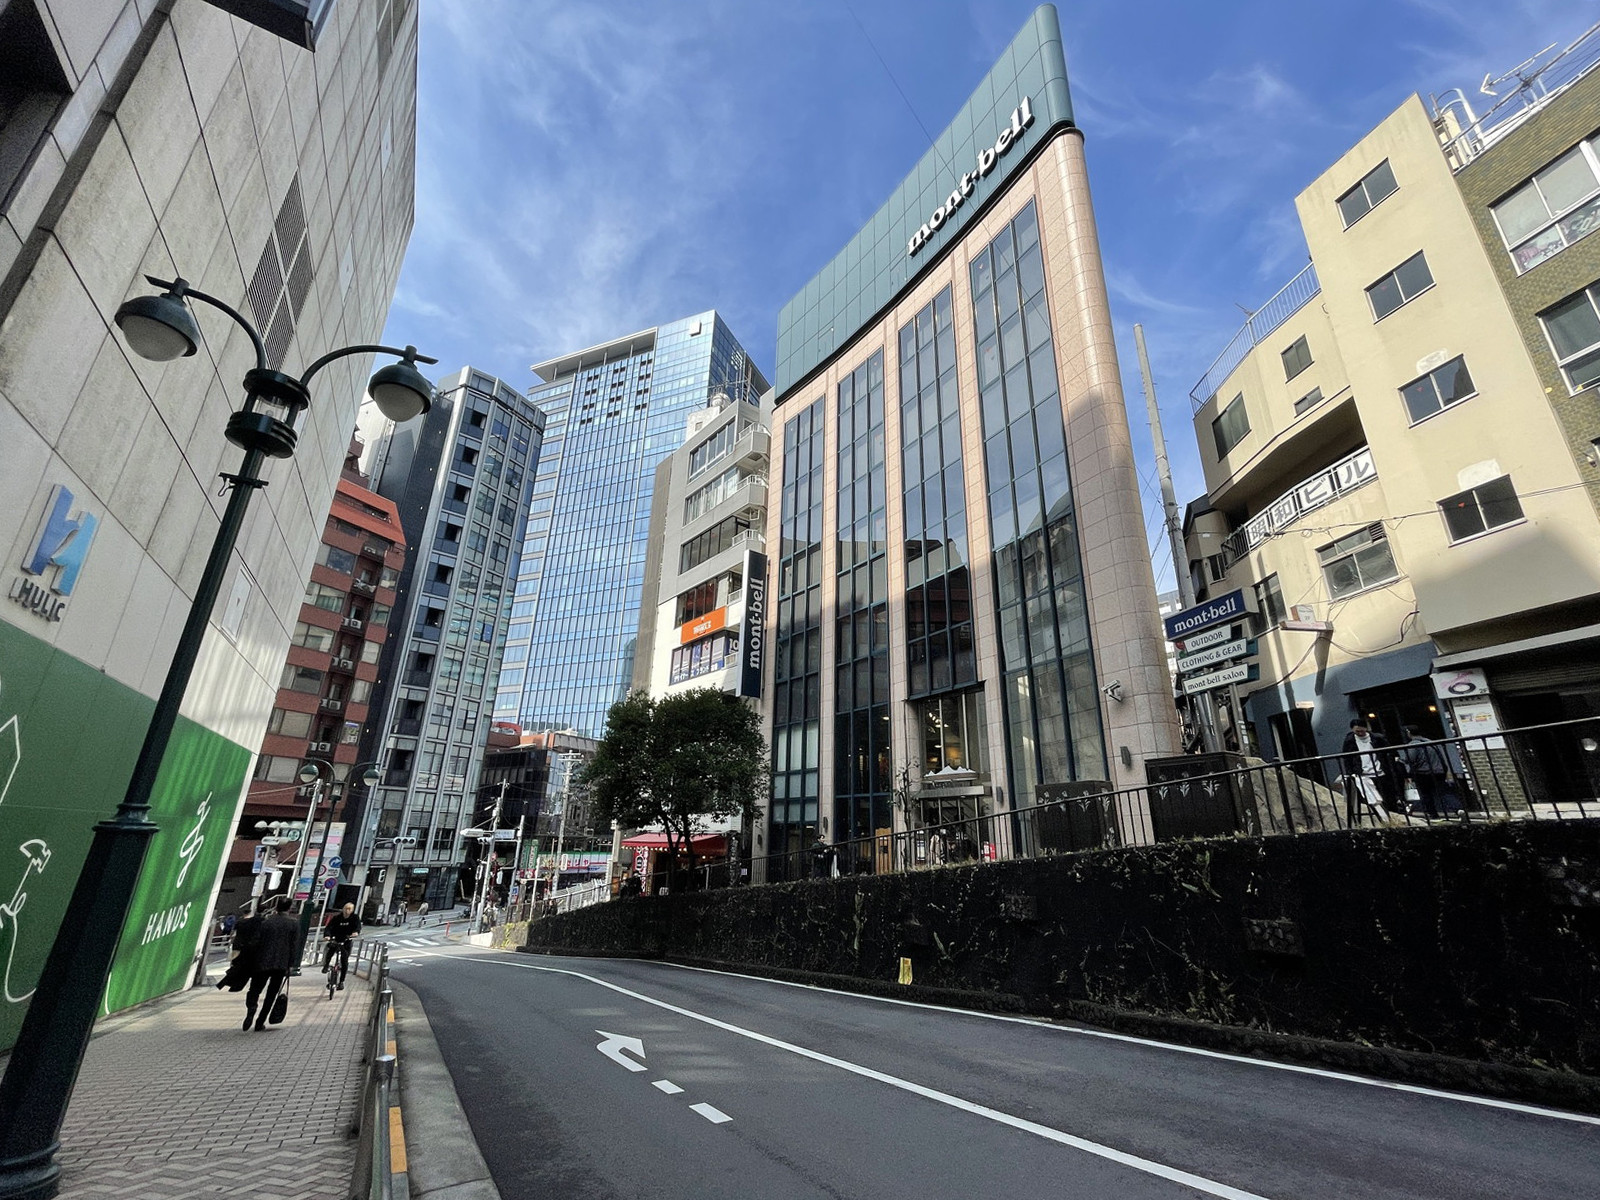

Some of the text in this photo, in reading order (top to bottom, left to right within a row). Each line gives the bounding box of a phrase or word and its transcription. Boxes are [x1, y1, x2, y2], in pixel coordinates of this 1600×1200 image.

[1250, 460, 1370, 540] 昭和ビル
[1191, 631, 1223, 648] OUTDOOR
[1181, 652, 1215, 669] CLOTHING
[1222, 643, 1243, 656] GEAR
[1222, 670, 1245, 681] salon
[141, 901, 192, 946] HANDS
